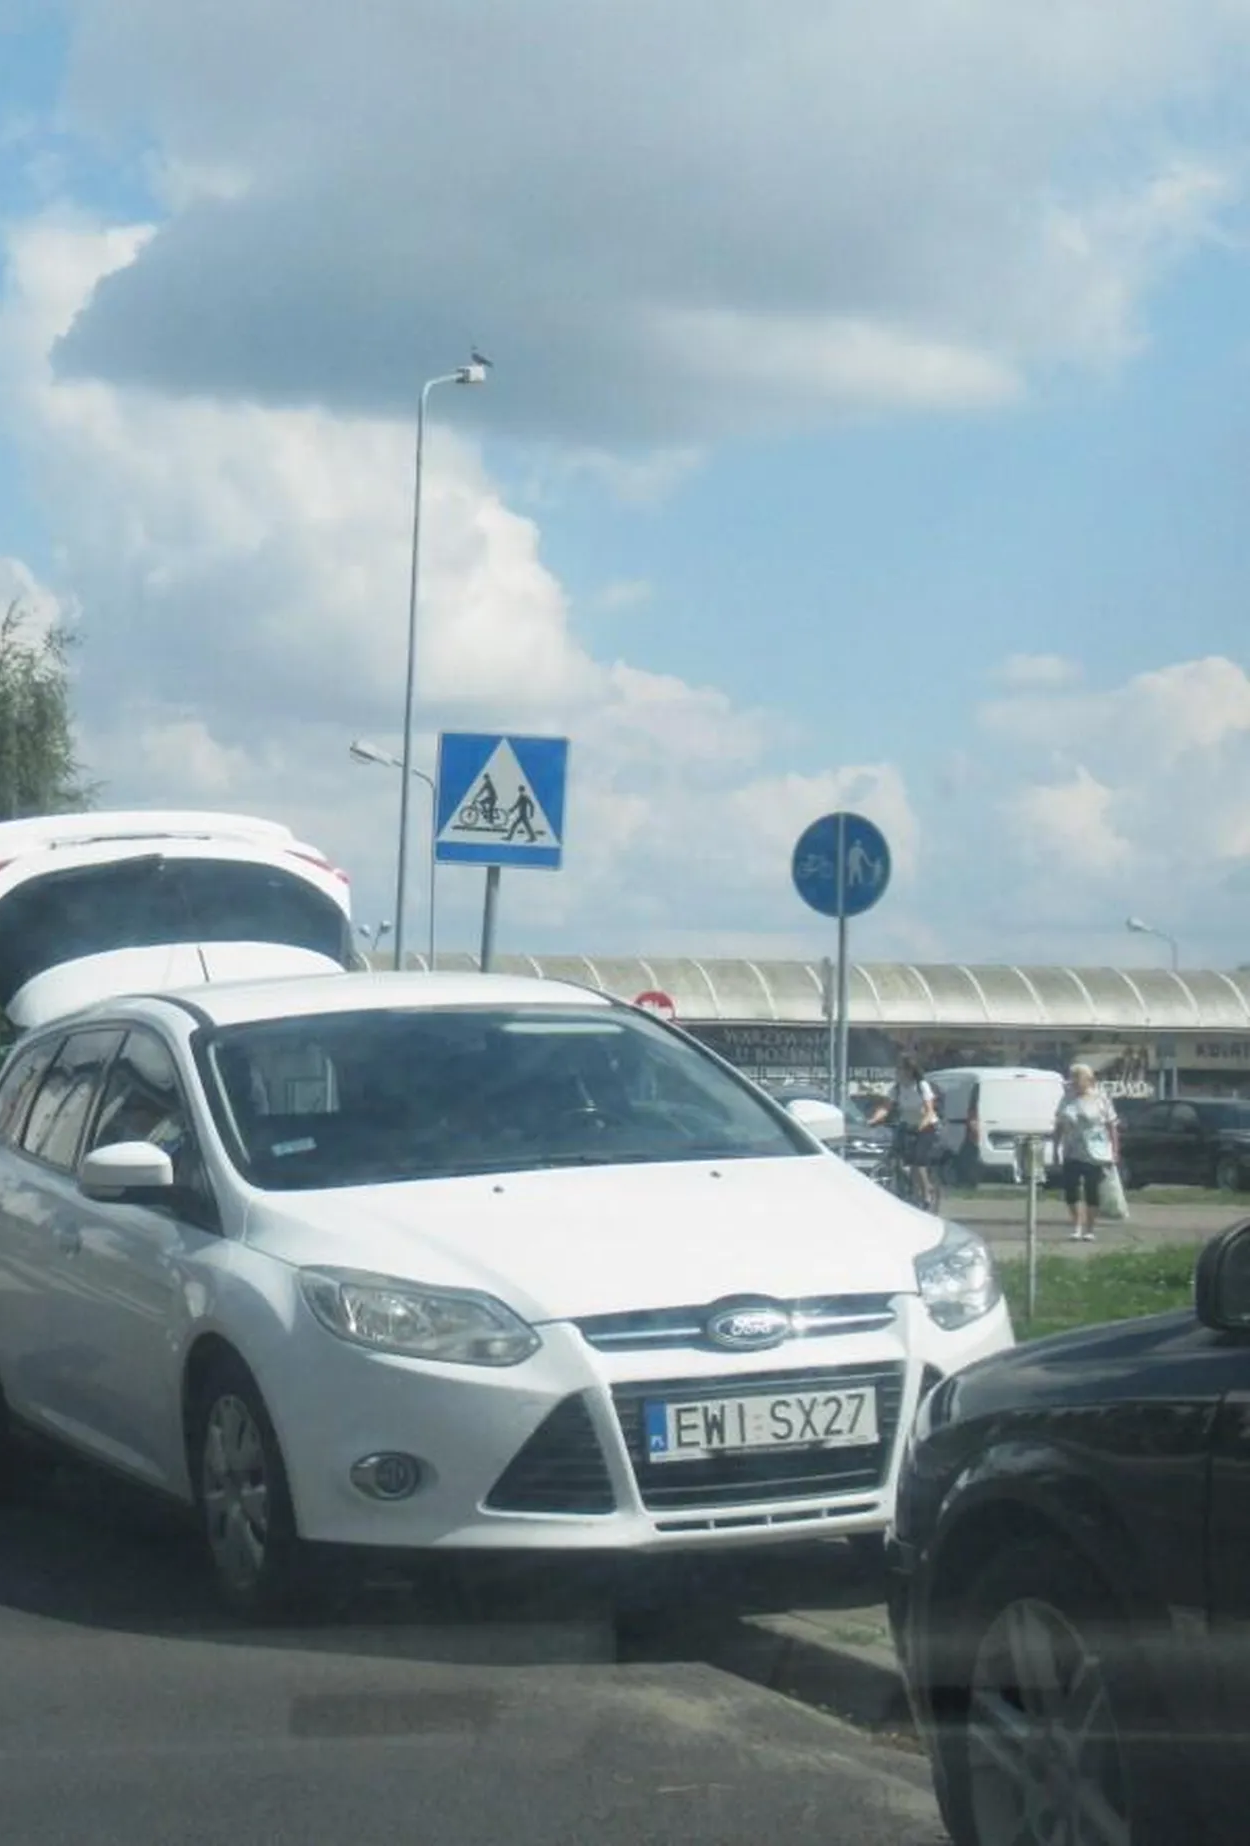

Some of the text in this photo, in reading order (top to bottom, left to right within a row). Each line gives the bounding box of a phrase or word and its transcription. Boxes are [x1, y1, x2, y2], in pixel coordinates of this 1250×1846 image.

[731, 1315, 770, 1336] Ford
[674, 1394, 865, 1448] EWI SX27
